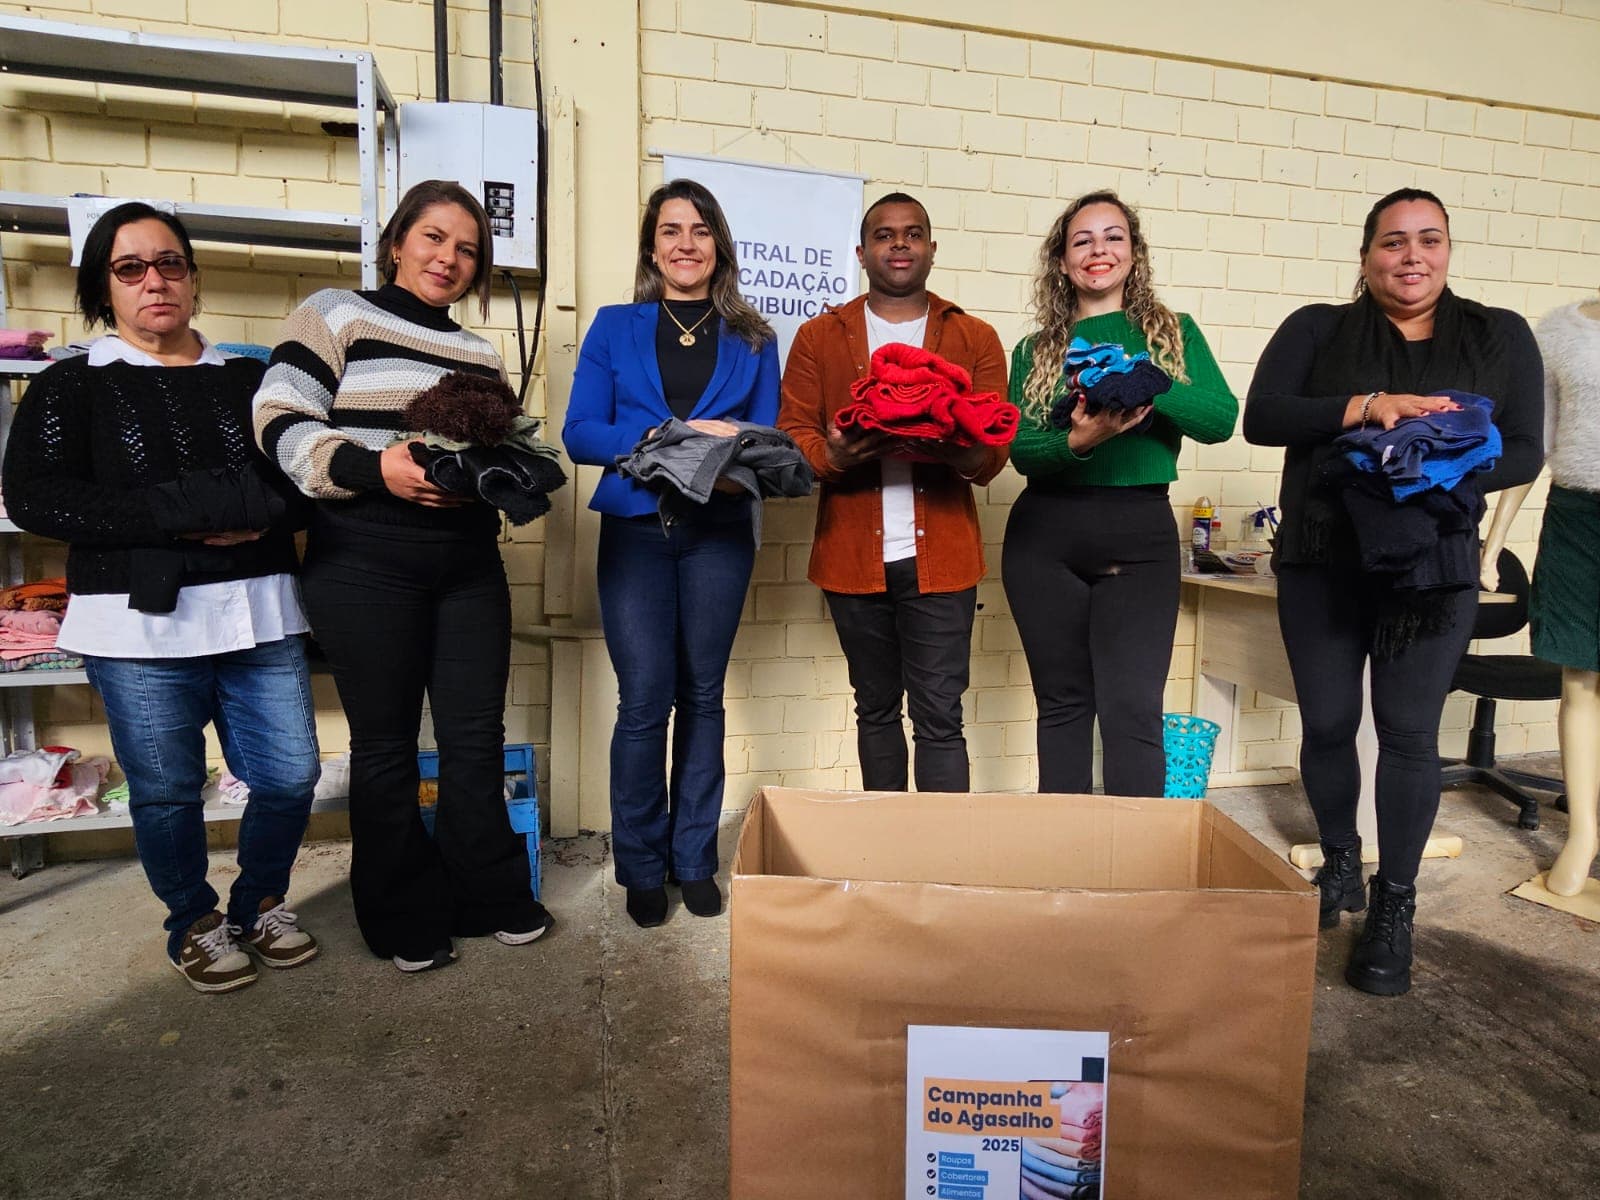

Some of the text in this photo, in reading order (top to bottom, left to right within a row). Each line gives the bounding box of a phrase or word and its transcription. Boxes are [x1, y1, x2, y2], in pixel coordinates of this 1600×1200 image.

[733, 240, 833, 267] TRAL DE
[738, 267, 847, 295] CADAÇÃO
[927, 1086, 1042, 1110] Campanha
[927, 1107, 1054, 1131] do Agasalho
[982, 1138, 1020, 1152] 2025
[941, 1155, 972, 1166] Roupas
[941, 1171, 986, 1182] Cobertores
[941, 1187, 982, 1198] Alimentos
